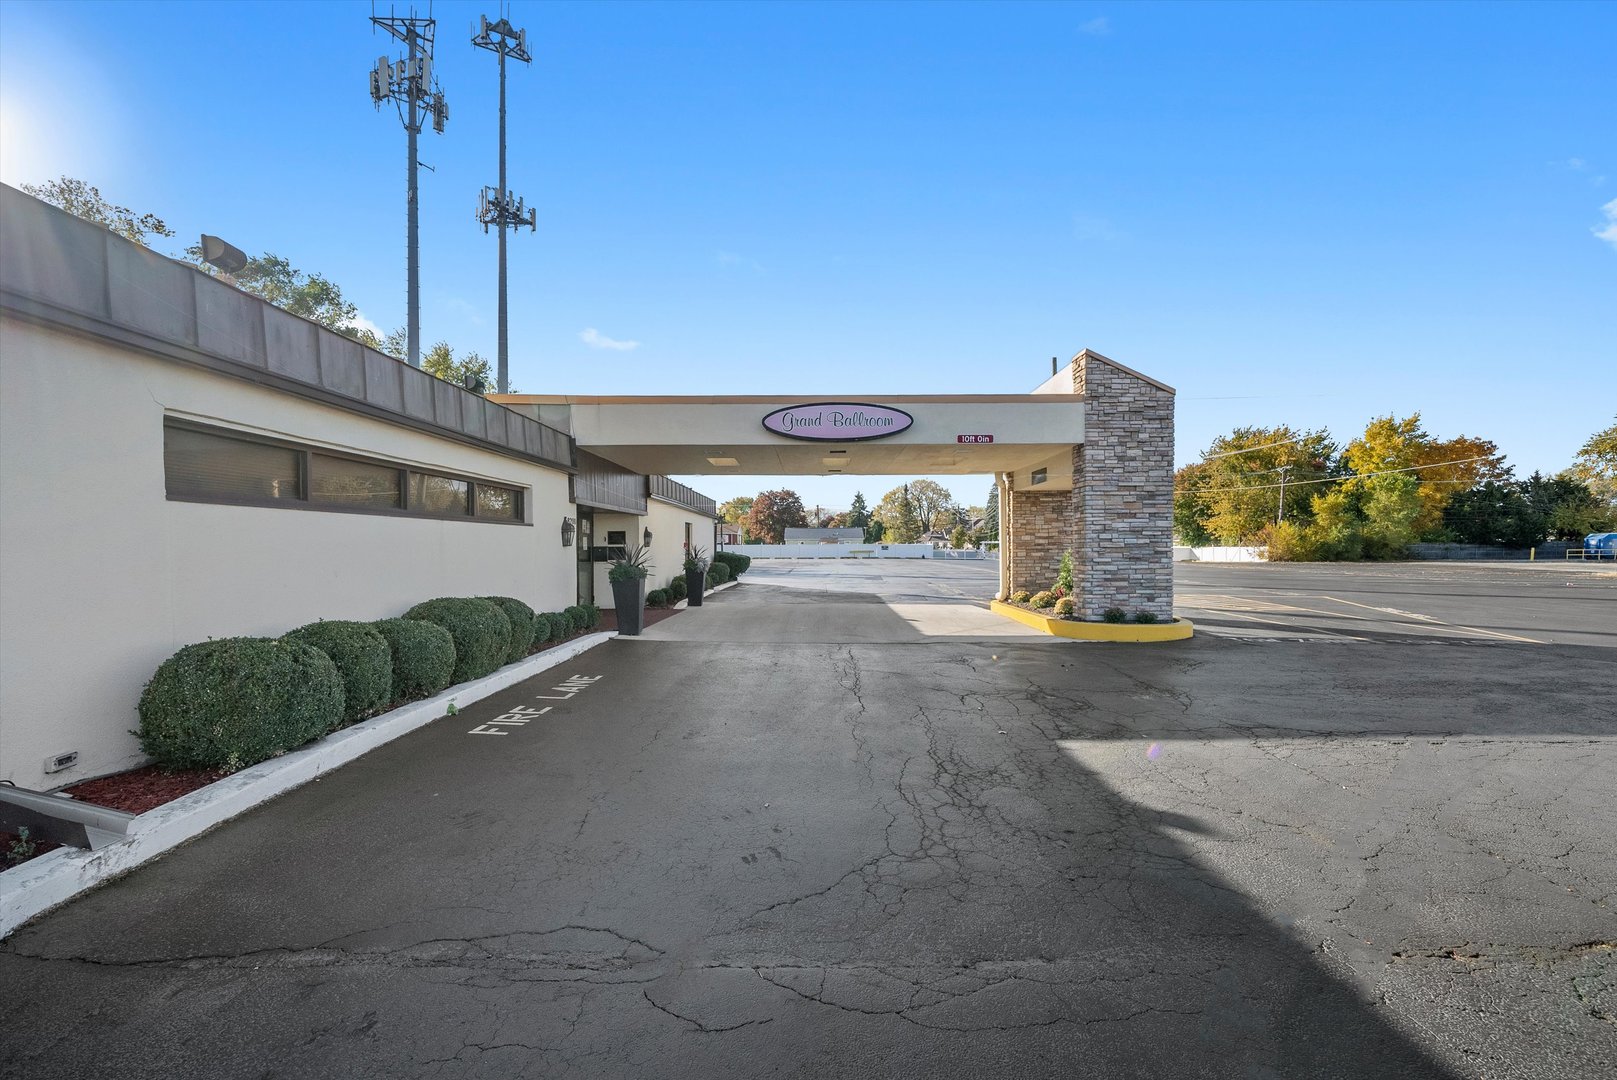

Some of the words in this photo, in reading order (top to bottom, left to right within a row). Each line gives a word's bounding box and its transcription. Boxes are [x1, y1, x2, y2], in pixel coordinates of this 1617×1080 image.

[782, 411, 823, 432] Grand
[827, 411, 894, 427] Ballroom
[962, 435, 975, 443] 10ft
[977, 435, 990, 443] 0in
[467, 705, 553, 735] FIRE
[535, 674, 603, 700] LANE
